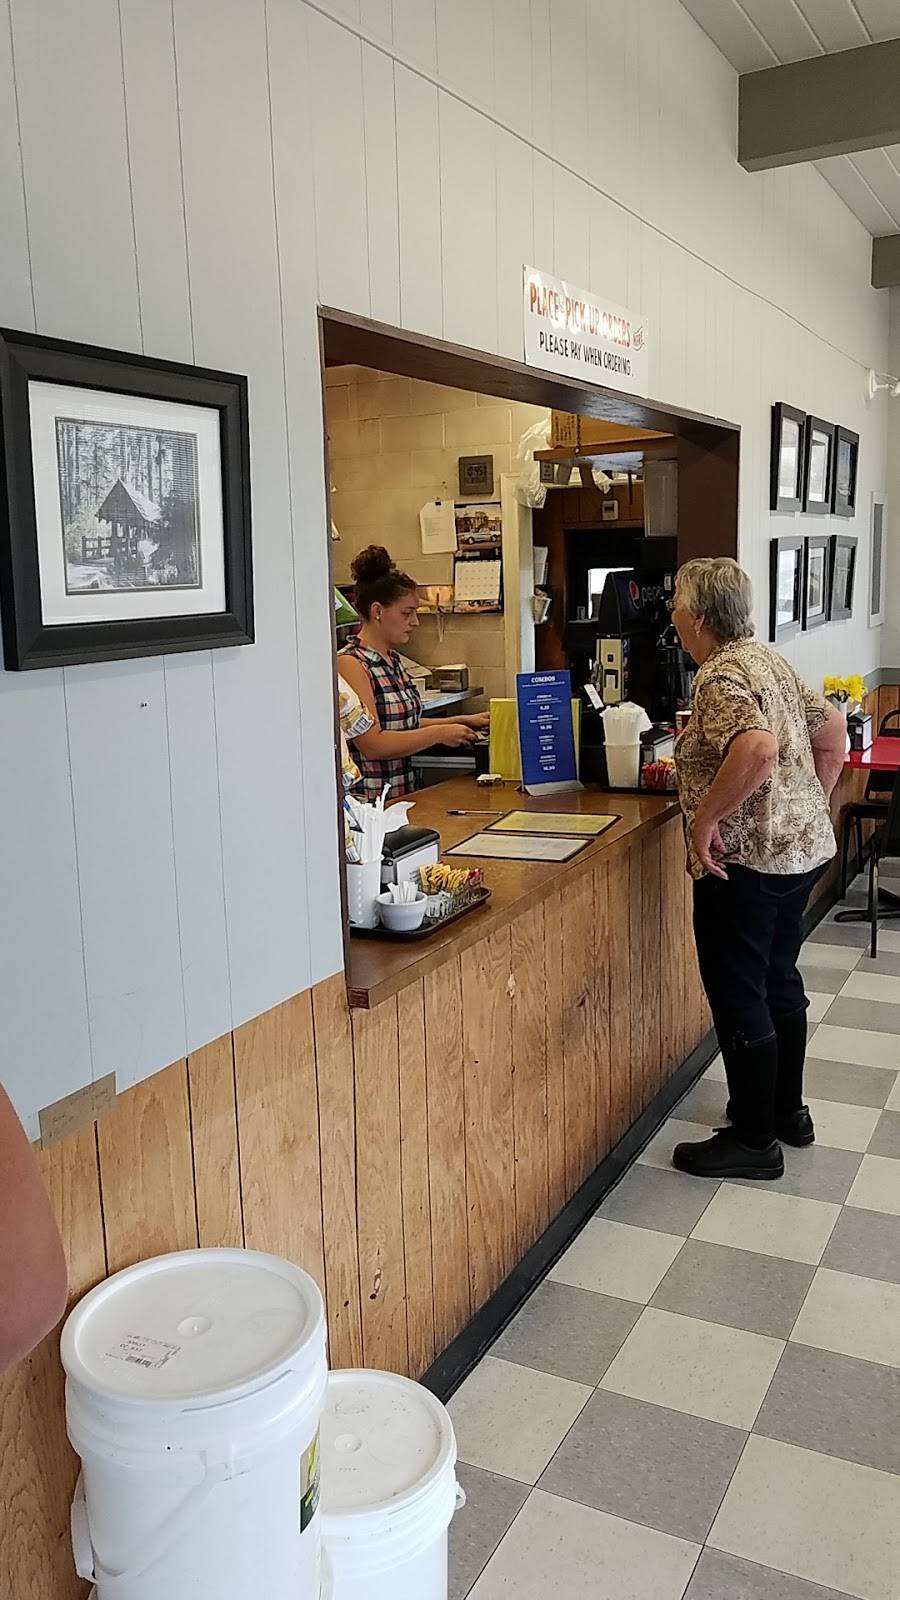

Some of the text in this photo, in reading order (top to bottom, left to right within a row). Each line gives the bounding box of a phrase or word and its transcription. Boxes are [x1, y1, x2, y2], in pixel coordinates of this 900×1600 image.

[530, 282, 559, 321] PLACE
[565, 296, 586, 331] PICK
[588, 303, 600, 336] UP
[539, 331, 569, 357] PLEASE
[570, 341, 582, 361] PAY
[583, 345, 602, 367] WHEN
[531, 675, 556, 683] COMBOS
